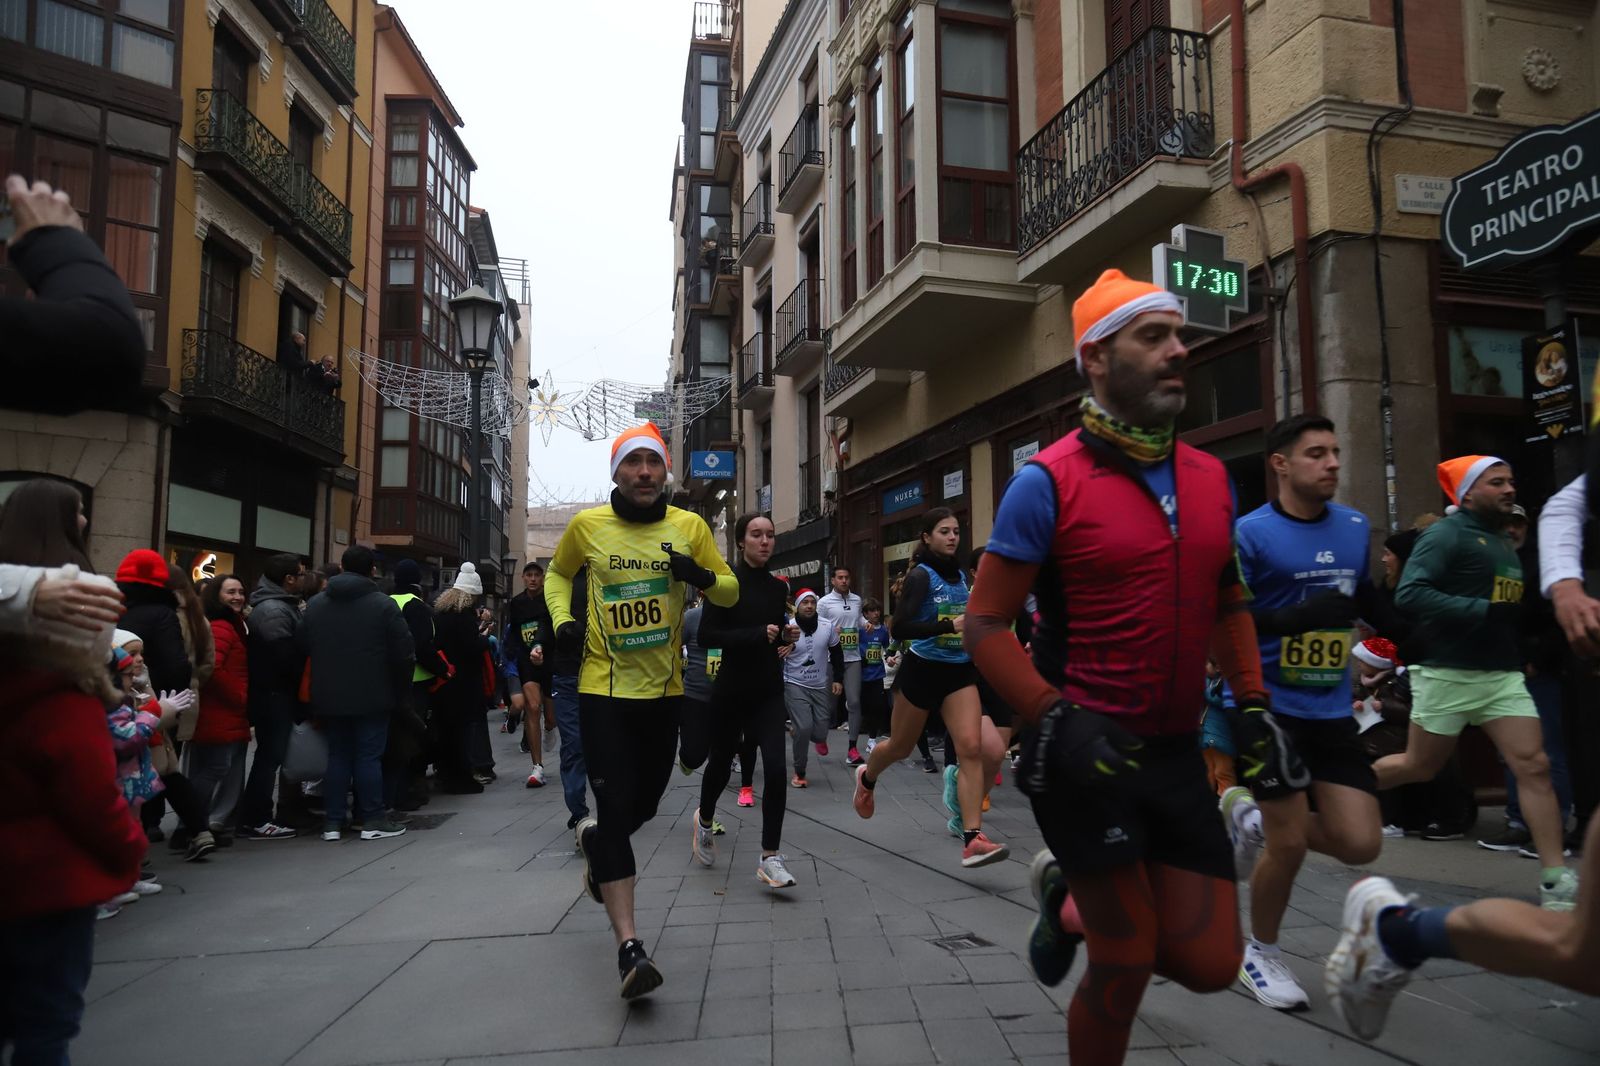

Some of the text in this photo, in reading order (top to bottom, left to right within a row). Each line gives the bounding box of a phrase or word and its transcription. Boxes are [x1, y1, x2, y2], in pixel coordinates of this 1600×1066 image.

[1481, 145, 1584, 206] TEATRO
[1418, 181, 1446, 190] CALLE
[1424, 191, 1436, 200] DE
[1172, 261, 1238, 296] 17:30
[693, 469, 732, 477] Samsonite
[894, 489, 913, 503] NUXE
[609, 555, 642, 570] RUN
[651, 560, 671, 571] GO
[1315, 551, 1335, 563] 46
[800, 560, 820, 575] WORLD
[608, 598, 662, 629] 1086
[625, 636, 646, 645] CAJA
[839, 634, 857, 645] 909
[1286, 637, 1343, 667] 689
